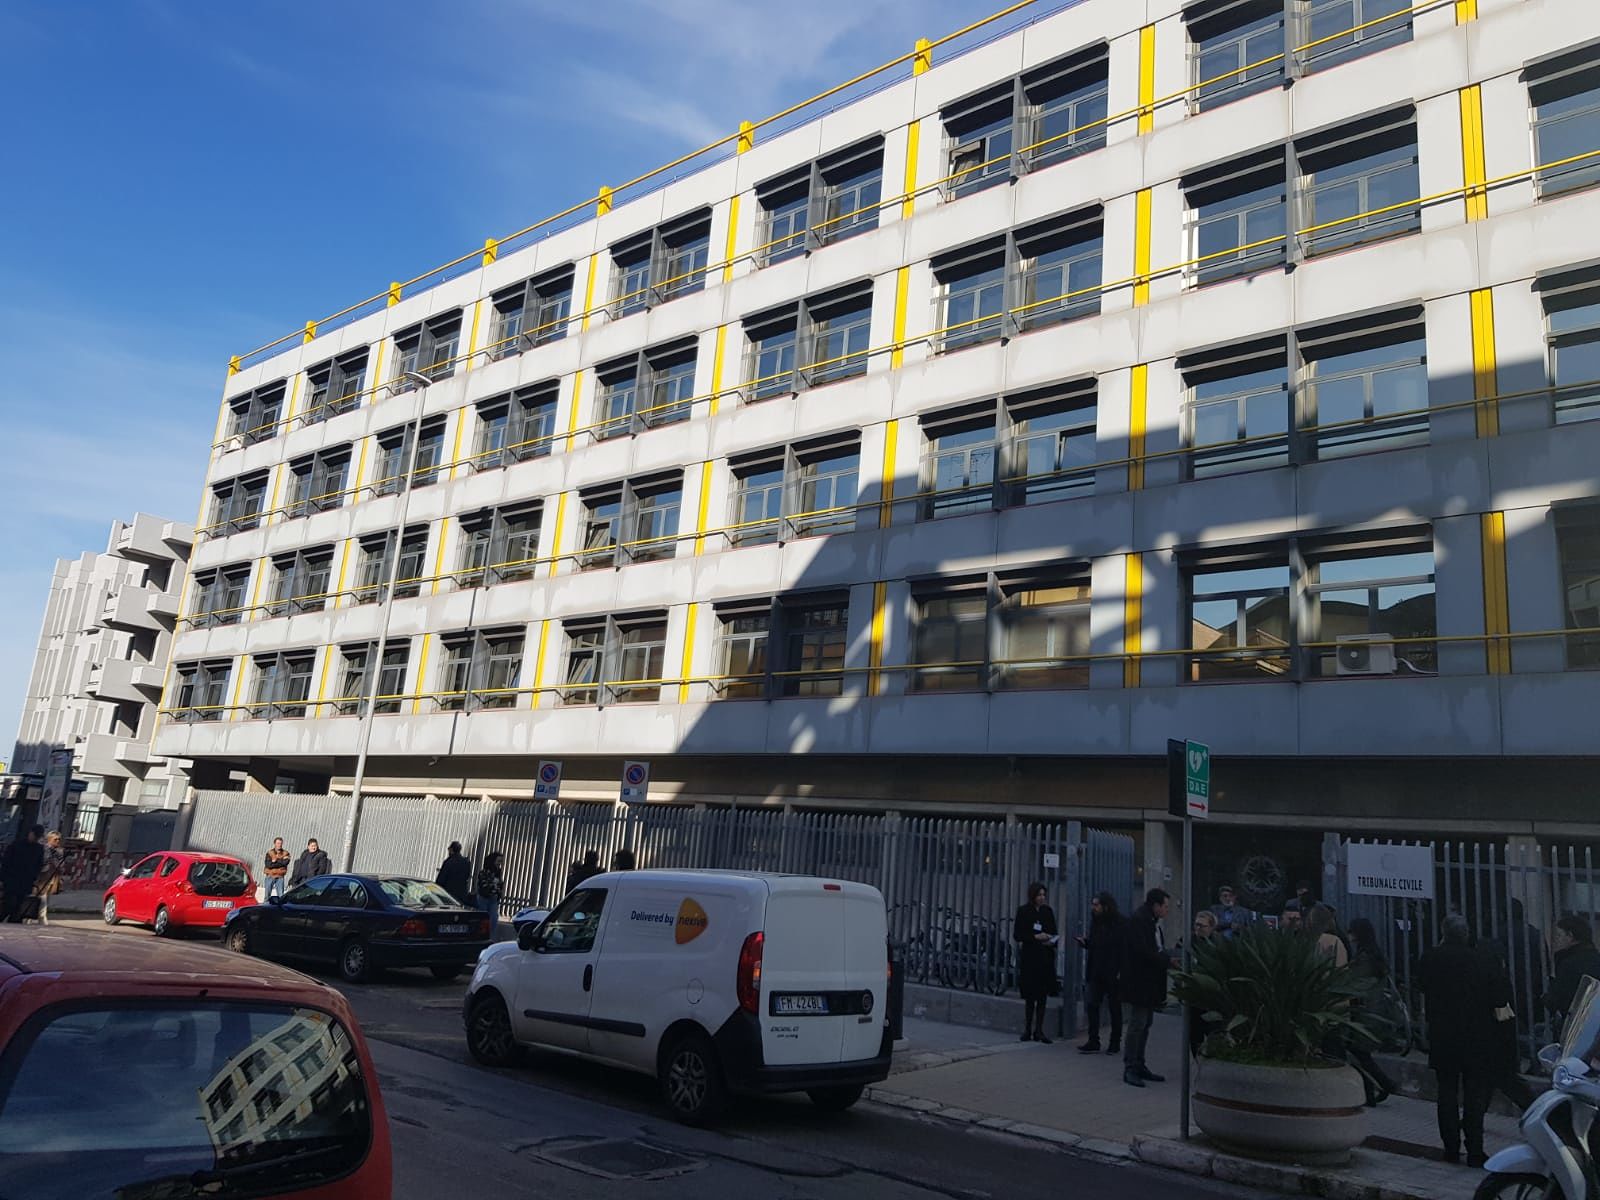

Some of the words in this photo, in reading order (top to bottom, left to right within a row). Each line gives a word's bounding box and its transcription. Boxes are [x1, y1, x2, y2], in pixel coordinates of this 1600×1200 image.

[1189, 780, 1207, 795] DAE
[1358, 876, 1397, 889] TRIBUNALE
[1398, 878, 1424, 891] CIVILE
[630, 910, 664, 923] Delivered
[664, 913, 675, 926] by
